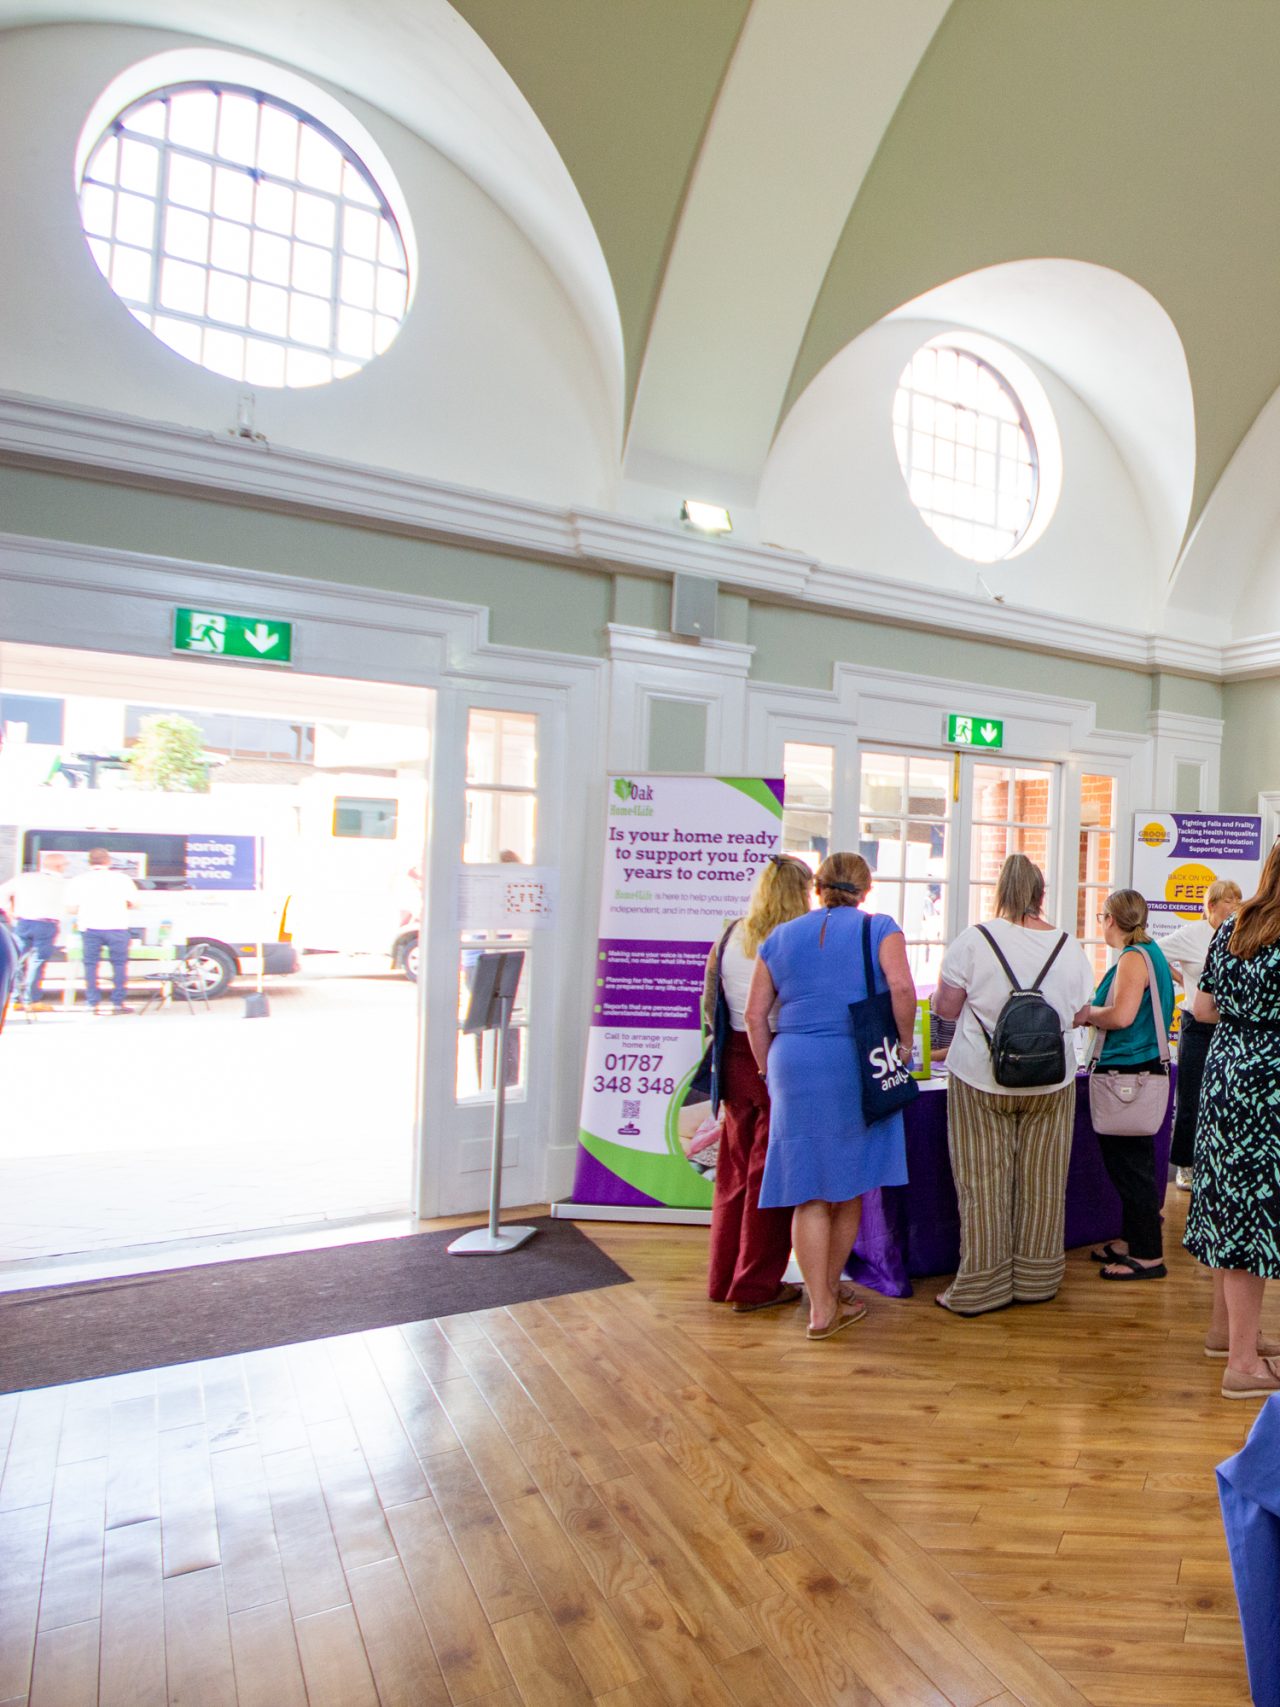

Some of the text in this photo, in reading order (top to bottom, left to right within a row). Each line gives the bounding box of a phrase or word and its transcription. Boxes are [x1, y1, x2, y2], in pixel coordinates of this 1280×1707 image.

[631, 784, 653, 800] Oak
[1182, 820, 1206, 828] Fighting
[609, 827, 779, 847] Is your home ready
[1178, 828, 1202, 836] Tackling
[1181, 837, 1209, 845] Reducing
[616, 847, 768, 865] to support you for
[1189, 846, 1223, 854] Supporting
[184, 866, 232, 879] ervice
[624, 867, 755, 882] years to come?
[1174, 884, 1208, 898] FEE
[605, 1032, 619, 1040] Call
[631, 1034, 661, 1042] arrange
[605, 1053, 663, 1072] 01787
[593, 1075, 674, 1095] 348 348
